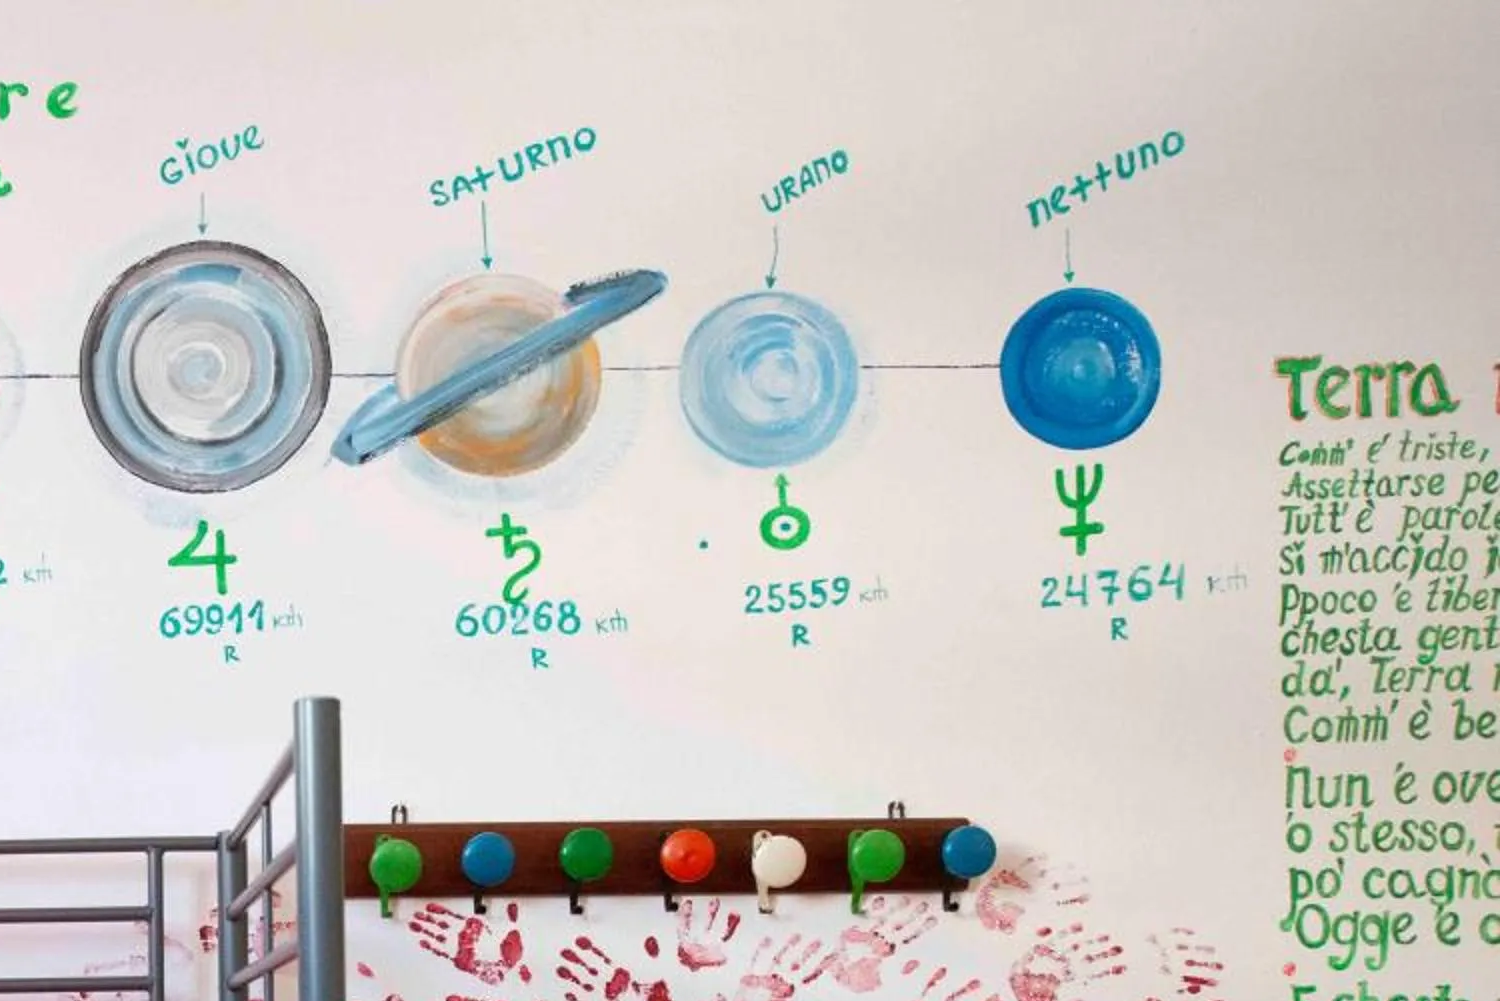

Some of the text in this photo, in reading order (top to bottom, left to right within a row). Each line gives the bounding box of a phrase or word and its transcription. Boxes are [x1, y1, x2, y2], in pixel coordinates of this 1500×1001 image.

[1273, 354, 1462, 421] Terra
[1278, 468, 1446, 500] Assettarse
[741, 575, 852, 616] 25559
[1039, 560, 1188, 609] 24764
[158, 600, 267, 640] 69911
[454, 597, 583, 639] 60268
[791, 623, 811, 646] R
[1110, 612, 1128, 640] R
[222, 643, 239, 664] R
[530, 647, 549, 670] R
[1368, 655, 1474, 694] Terra
